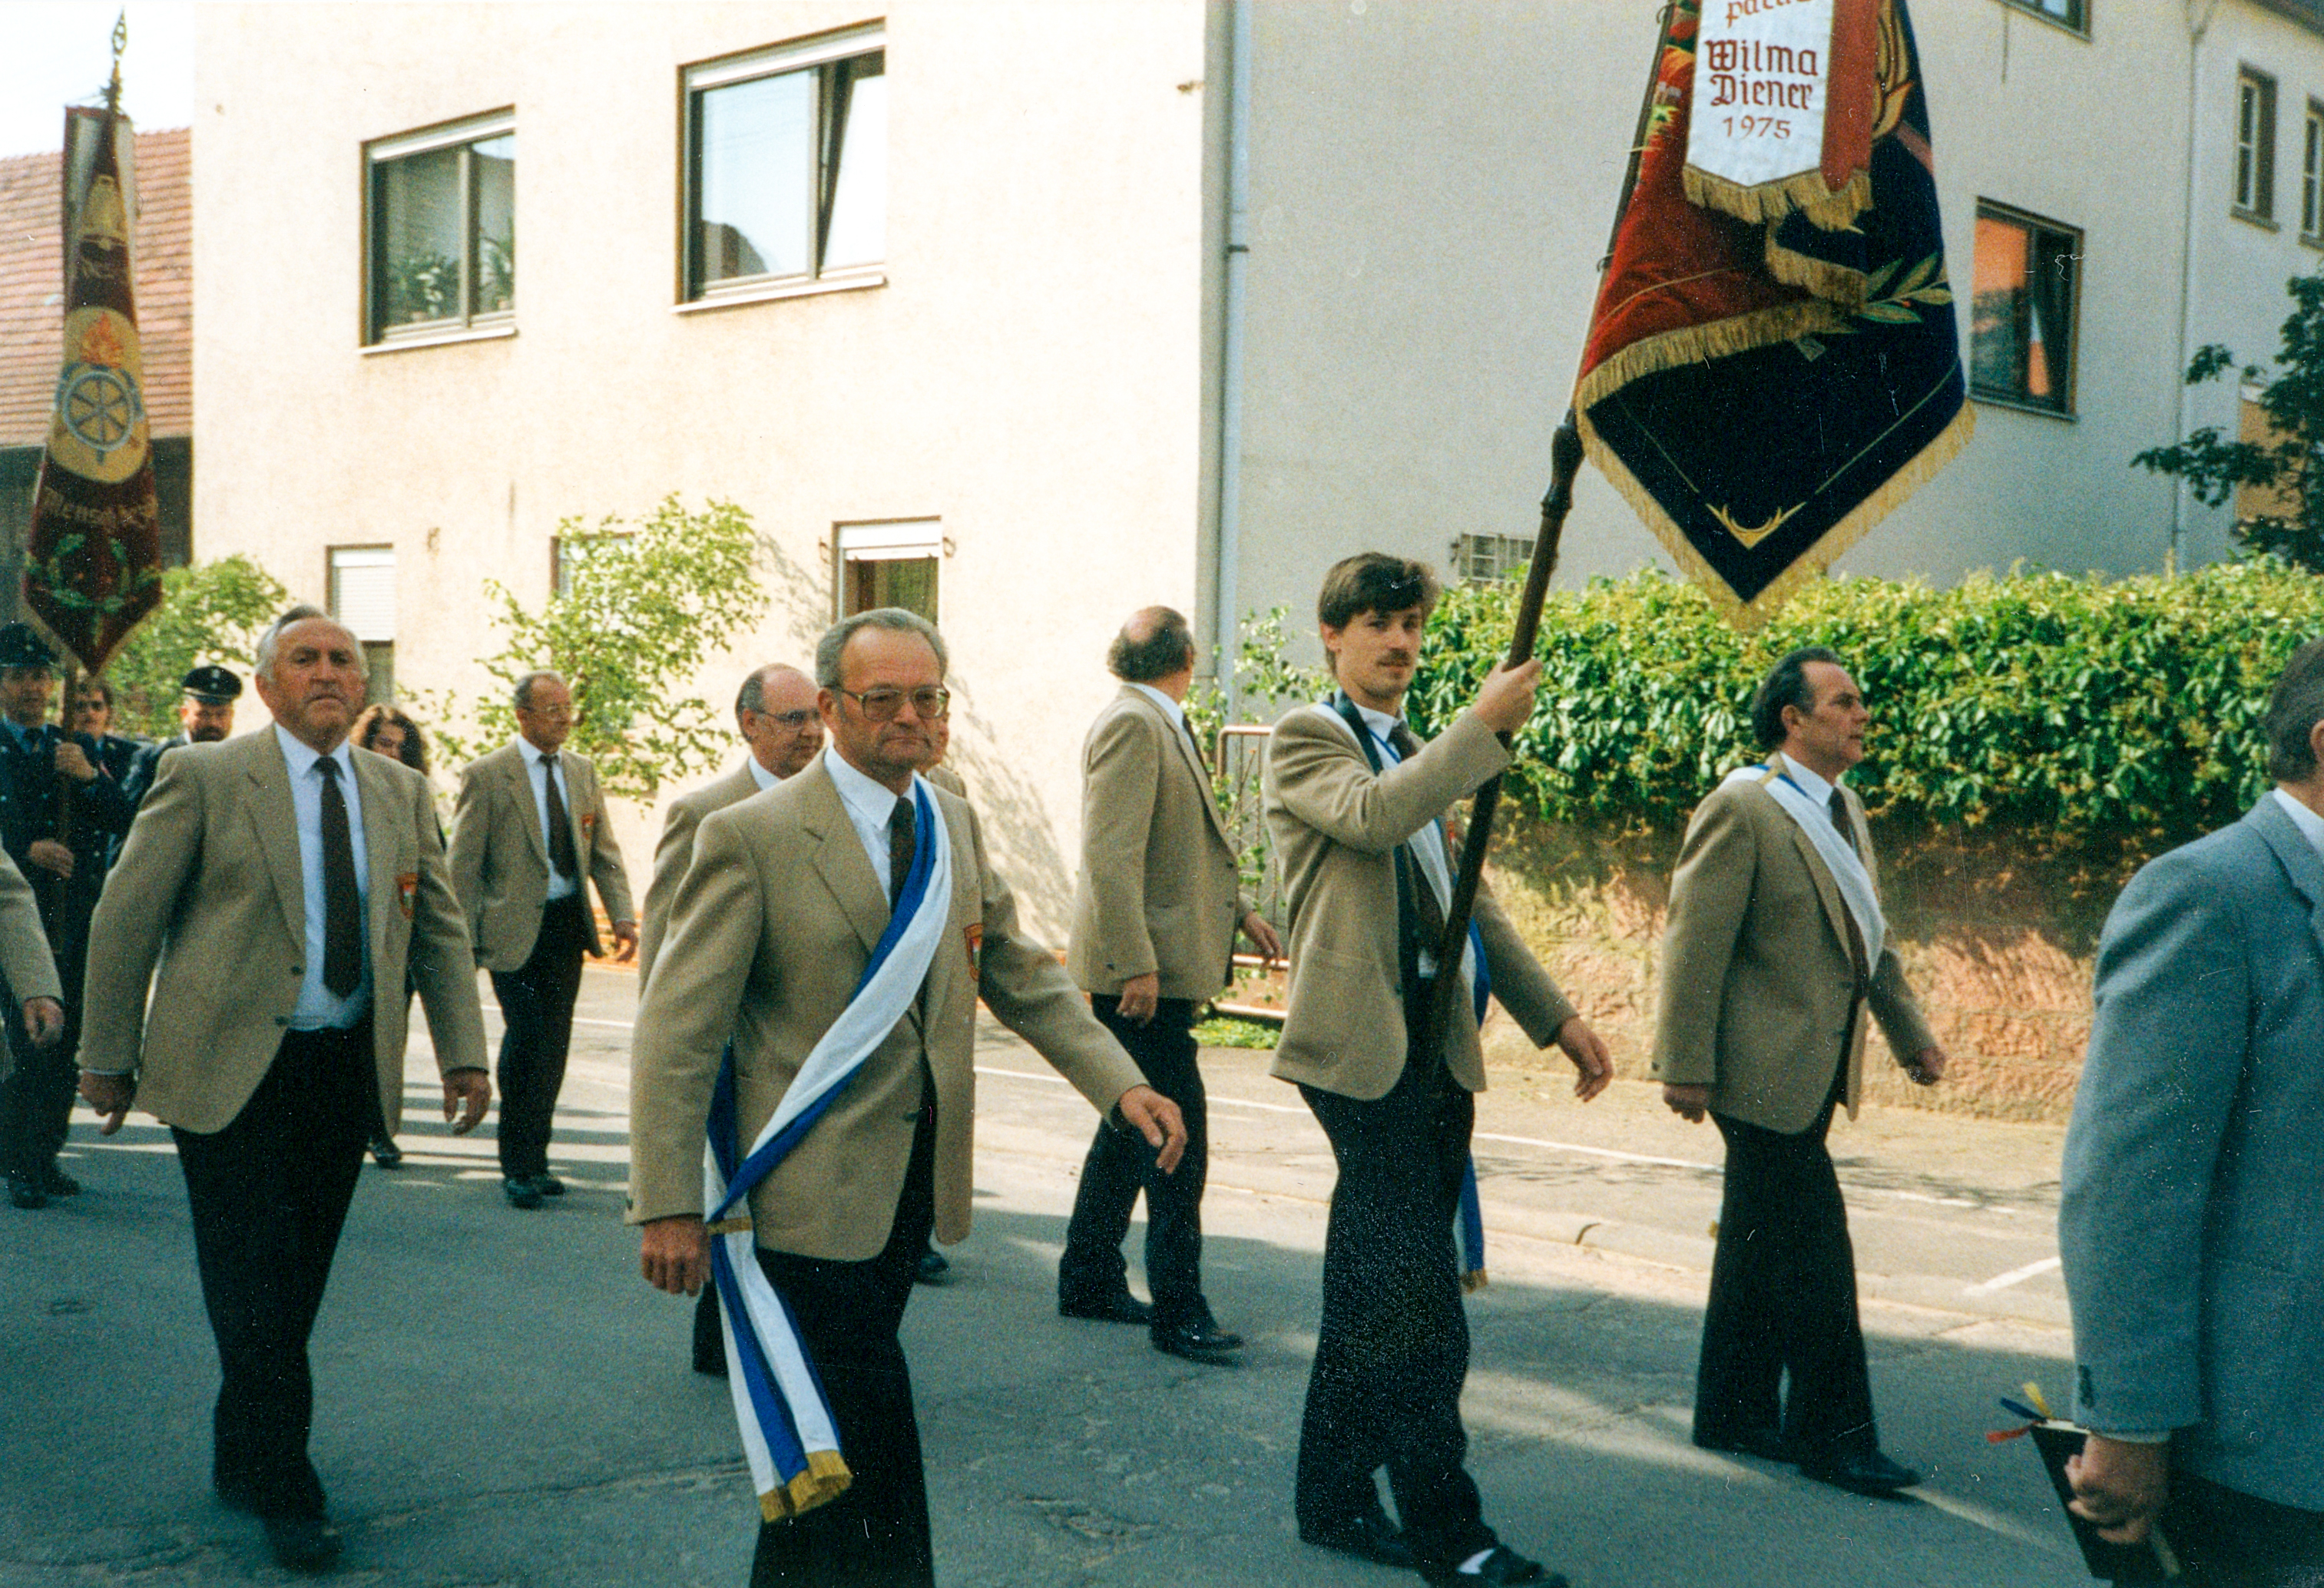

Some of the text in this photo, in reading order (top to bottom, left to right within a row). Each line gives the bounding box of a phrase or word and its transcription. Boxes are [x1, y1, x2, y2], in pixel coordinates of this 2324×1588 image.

[1704, 39, 1819, 76] Wilma
[1710, 74, 1813, 110] Diener
[1723, 114, 1791, 140] 1975
